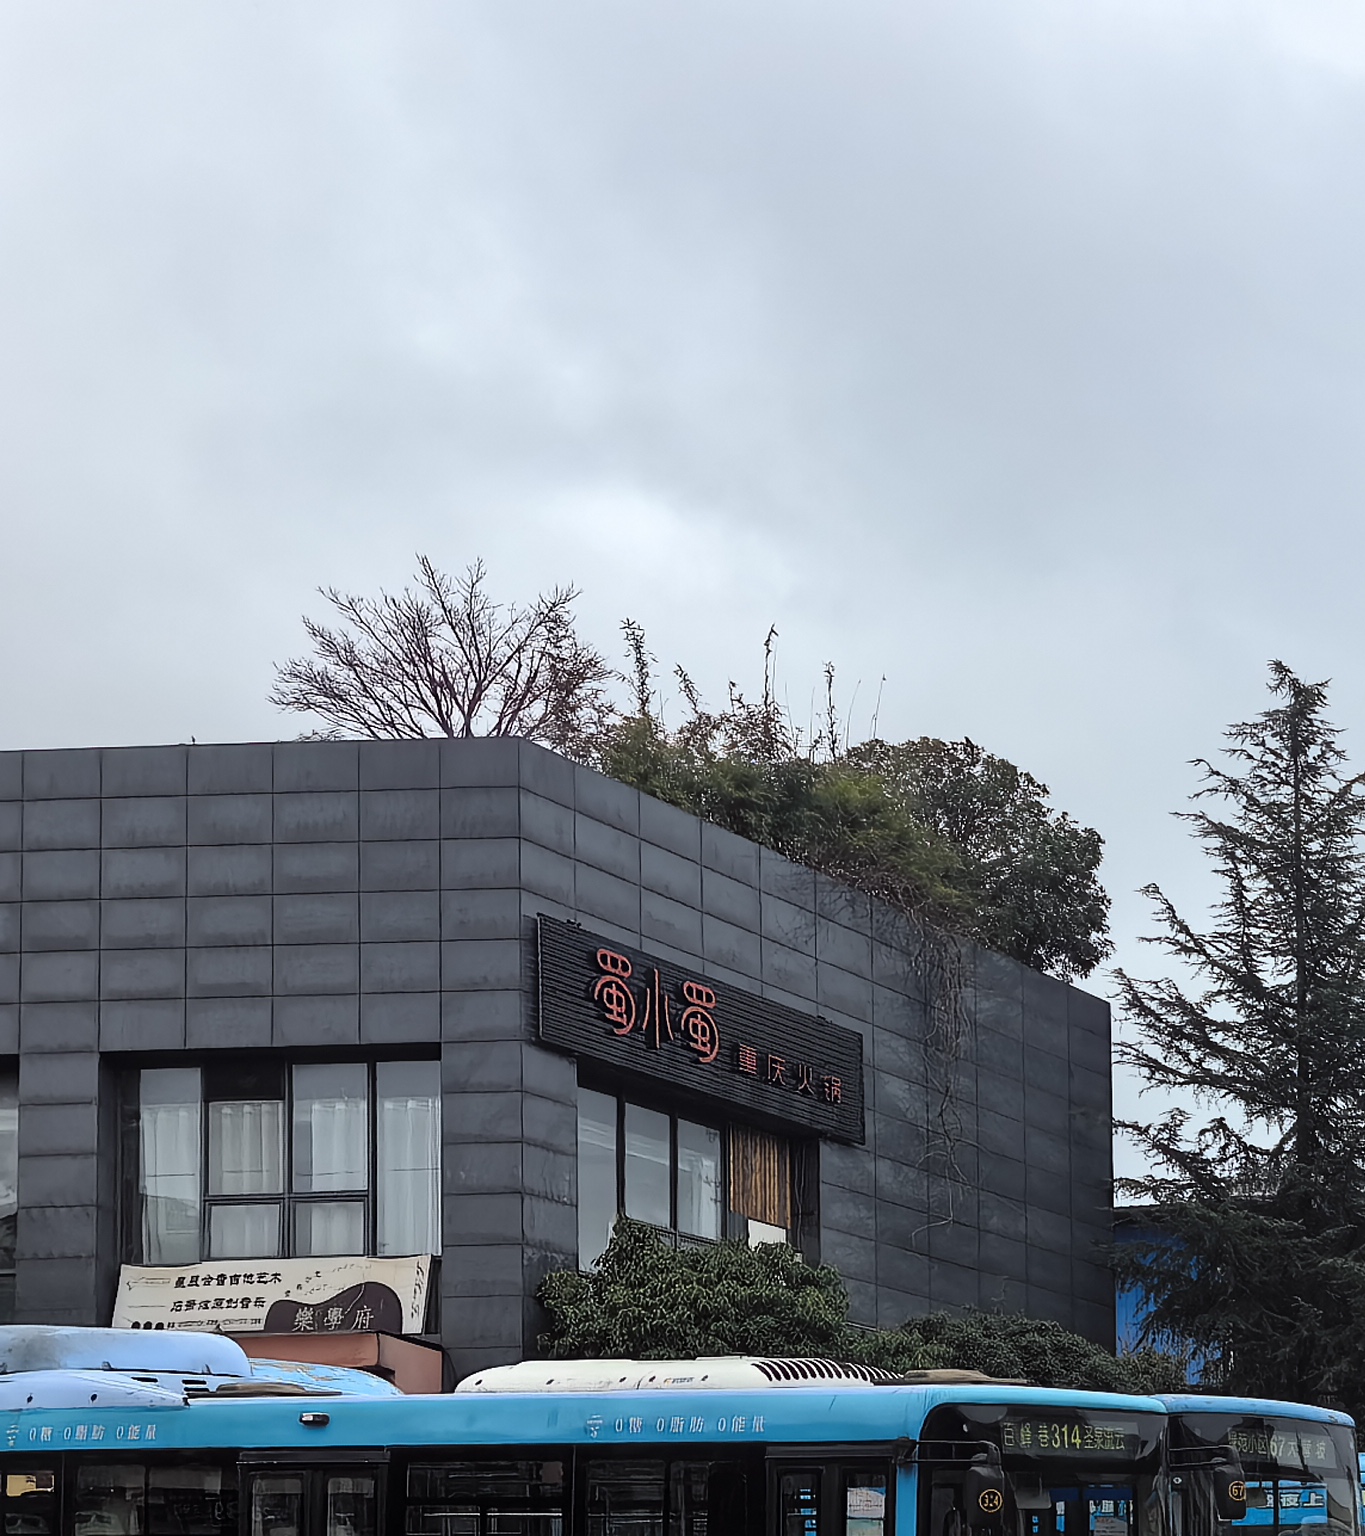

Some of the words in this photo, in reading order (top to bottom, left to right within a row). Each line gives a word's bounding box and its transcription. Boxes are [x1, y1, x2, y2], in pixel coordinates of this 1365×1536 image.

[594, 949, 719, 1063] 蜀小蜀
[739, 1044, 842, 1104] 重庆火锅
[292, 1305, 374, 1332] 樂學府
[1051, 1423, 1082, 1448] 314
[1270, 1434, 1284, 1459] 67
[1232, 1486, 1244, 1496] 67
